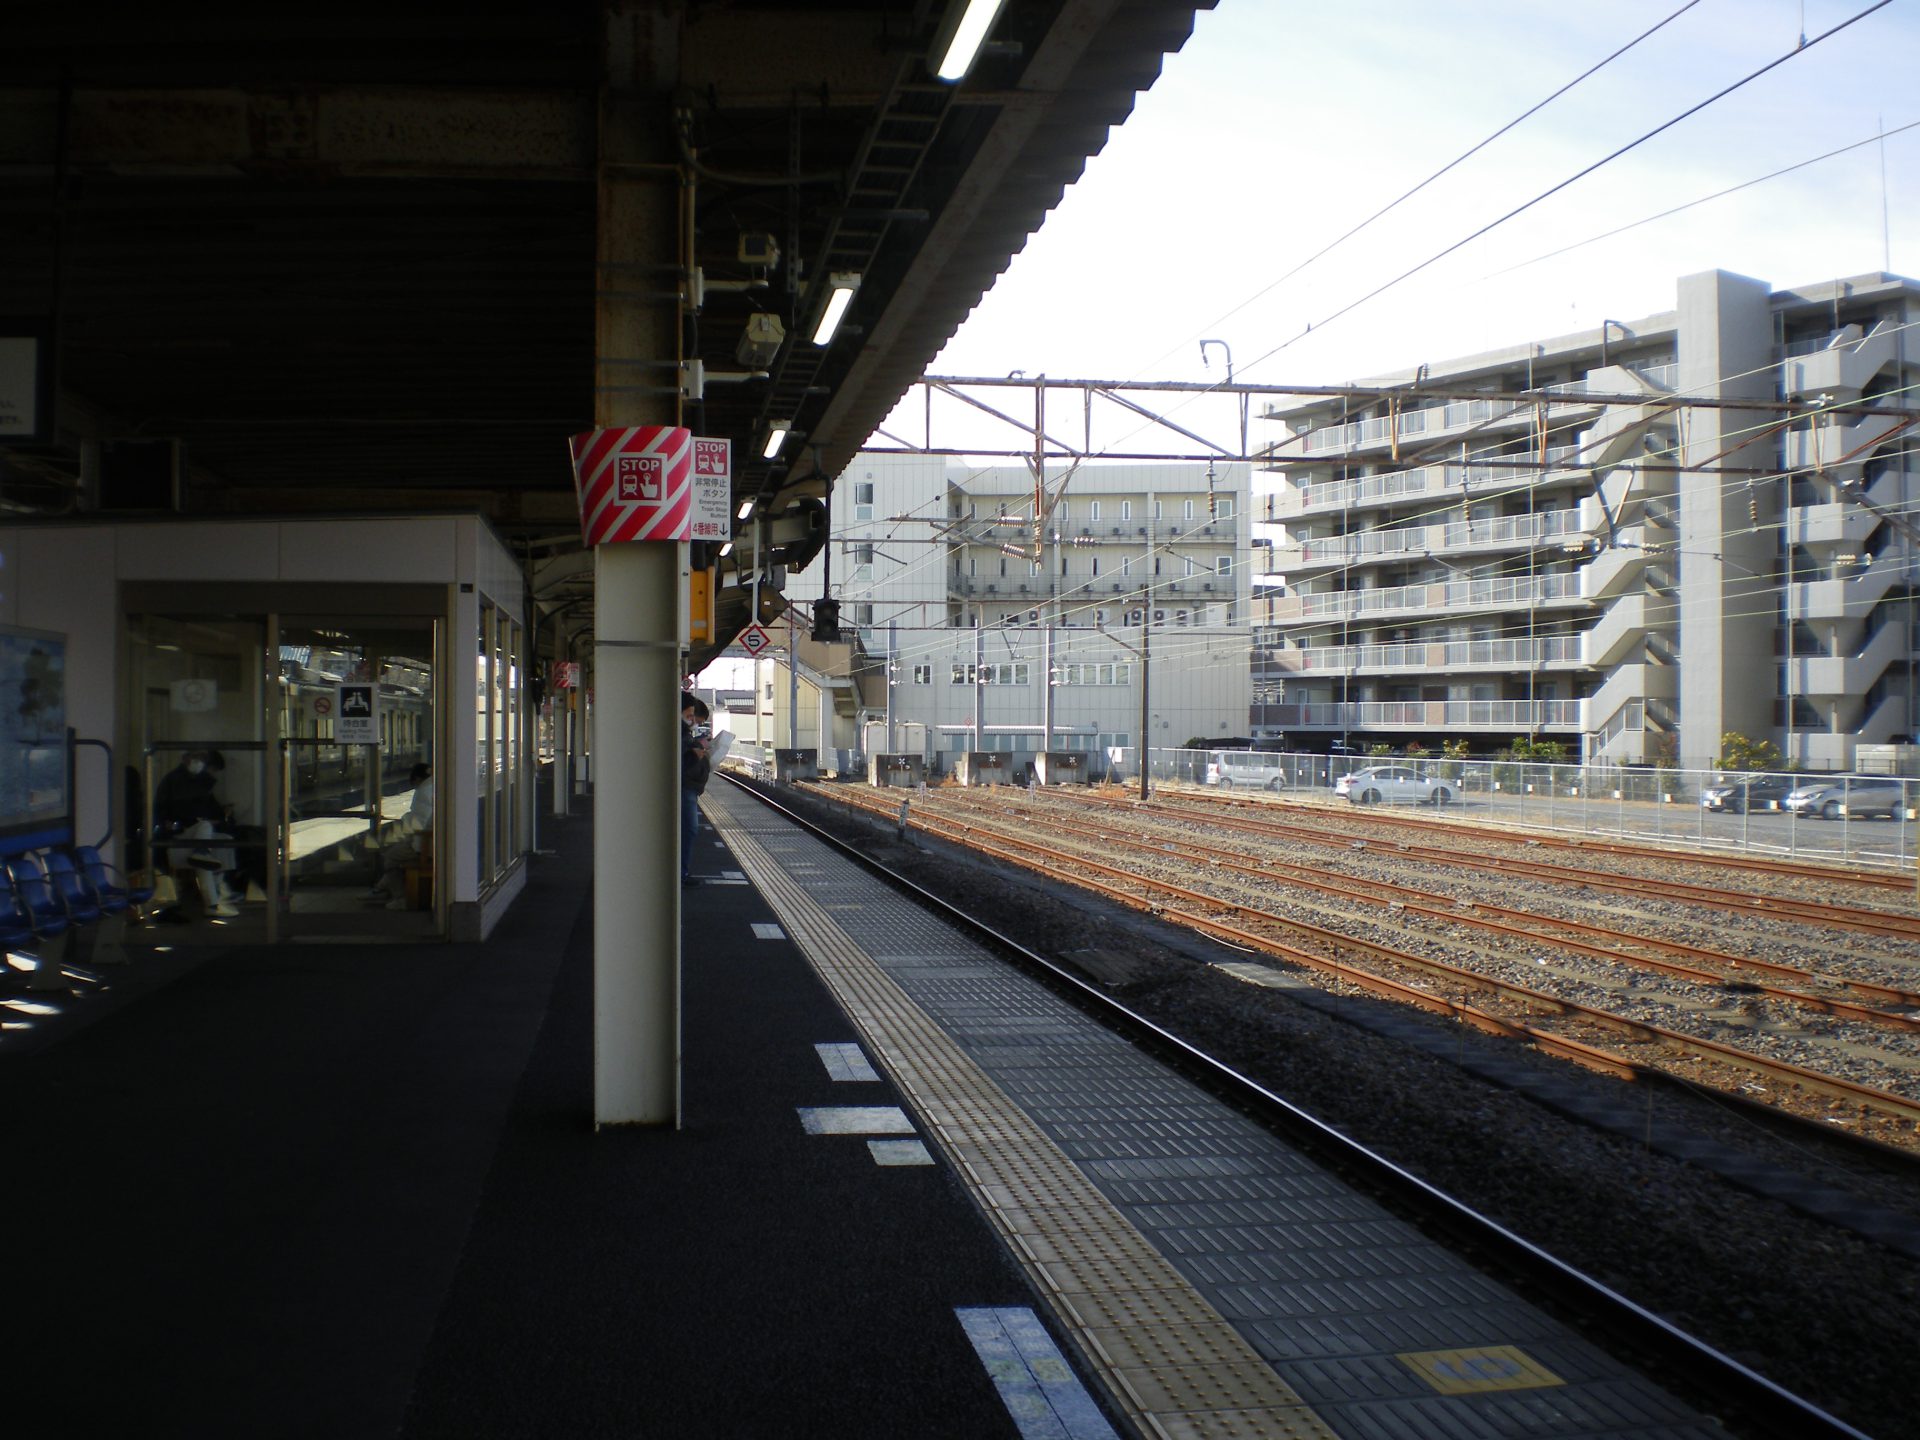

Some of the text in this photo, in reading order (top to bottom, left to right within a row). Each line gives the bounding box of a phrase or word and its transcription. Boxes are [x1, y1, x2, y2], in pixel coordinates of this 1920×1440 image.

[696, 442, 726, 452] STOP
[621, 459, 660, 472] STOP
[695, 478, 727, 488] 非常停止
[703, 489, 727, 499] ボタン
[748, 635, 760, 647] 5
